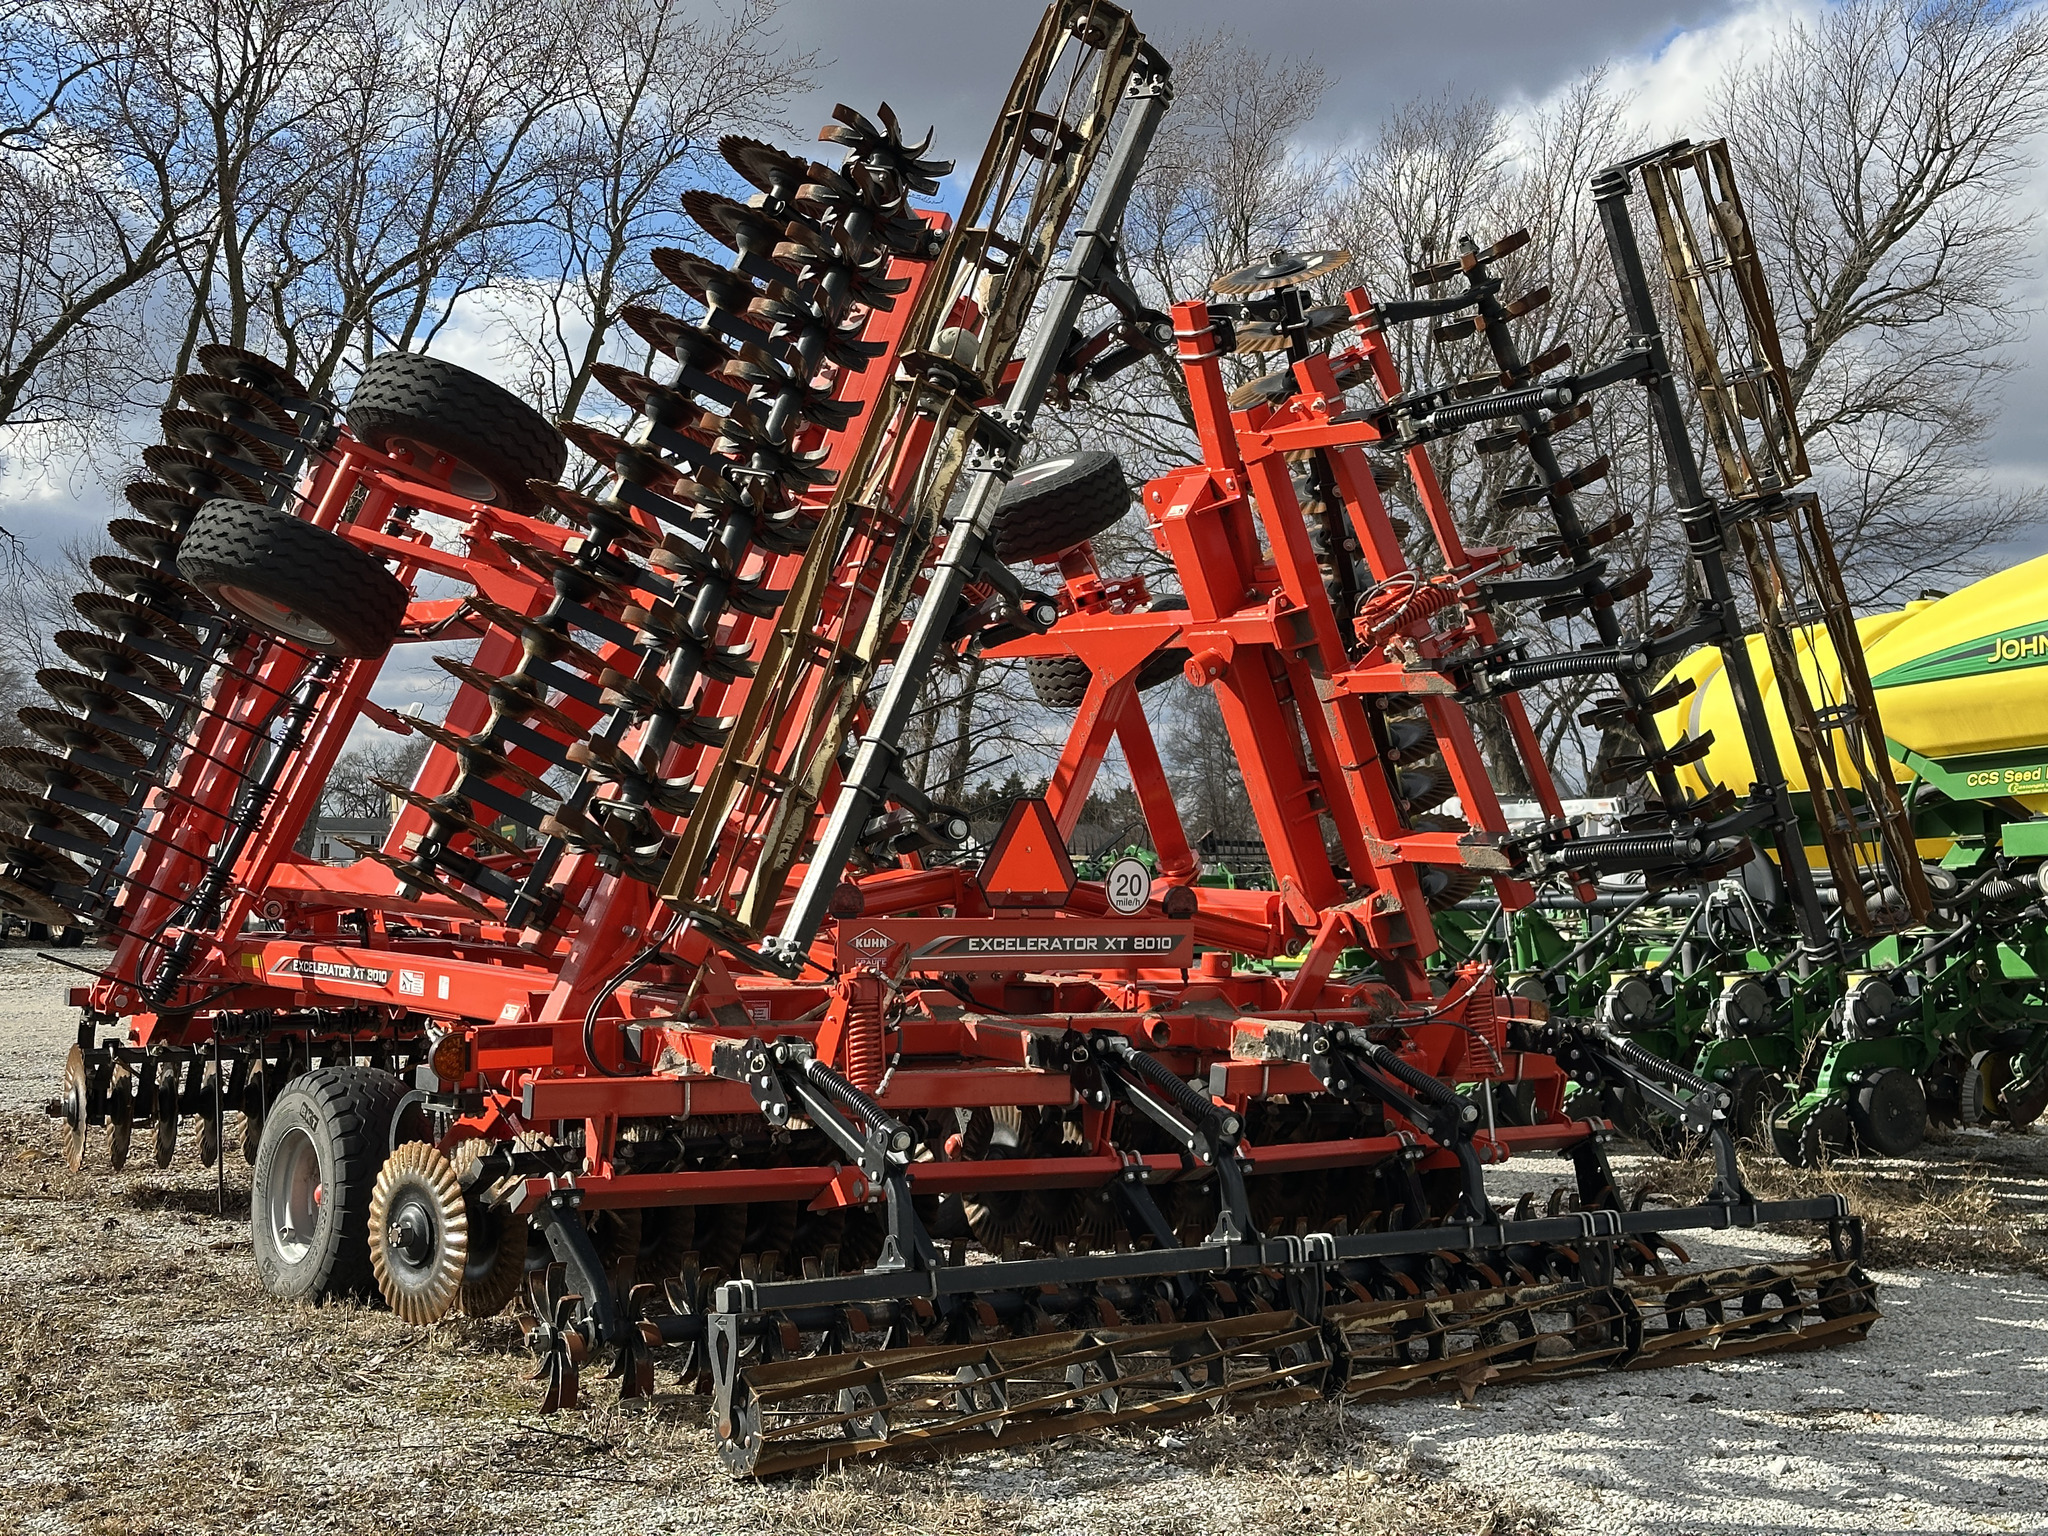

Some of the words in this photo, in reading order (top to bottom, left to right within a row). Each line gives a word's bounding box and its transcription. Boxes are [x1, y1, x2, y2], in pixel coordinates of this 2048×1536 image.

[1966, 771, 2000, 787] CCS
[2003, 767, 2042, 783] Seed
[1116, 873, 1142, 896] 20
[1116, 898, 1141, 906] mile/h
[855, 938, 888, 948] KUHN
[968, 937, 1098, 951] EXCELERATOR
[1104, 937, 1128, 950] XT
[1133, 937, 1172, 950] 8010
[292, 959, 351, 979] EXCELERATOR
[353, 966, 366, 981] XT
[367, 968, 388, 983] 8010
[300, 1105, 318, 1129] BKT
